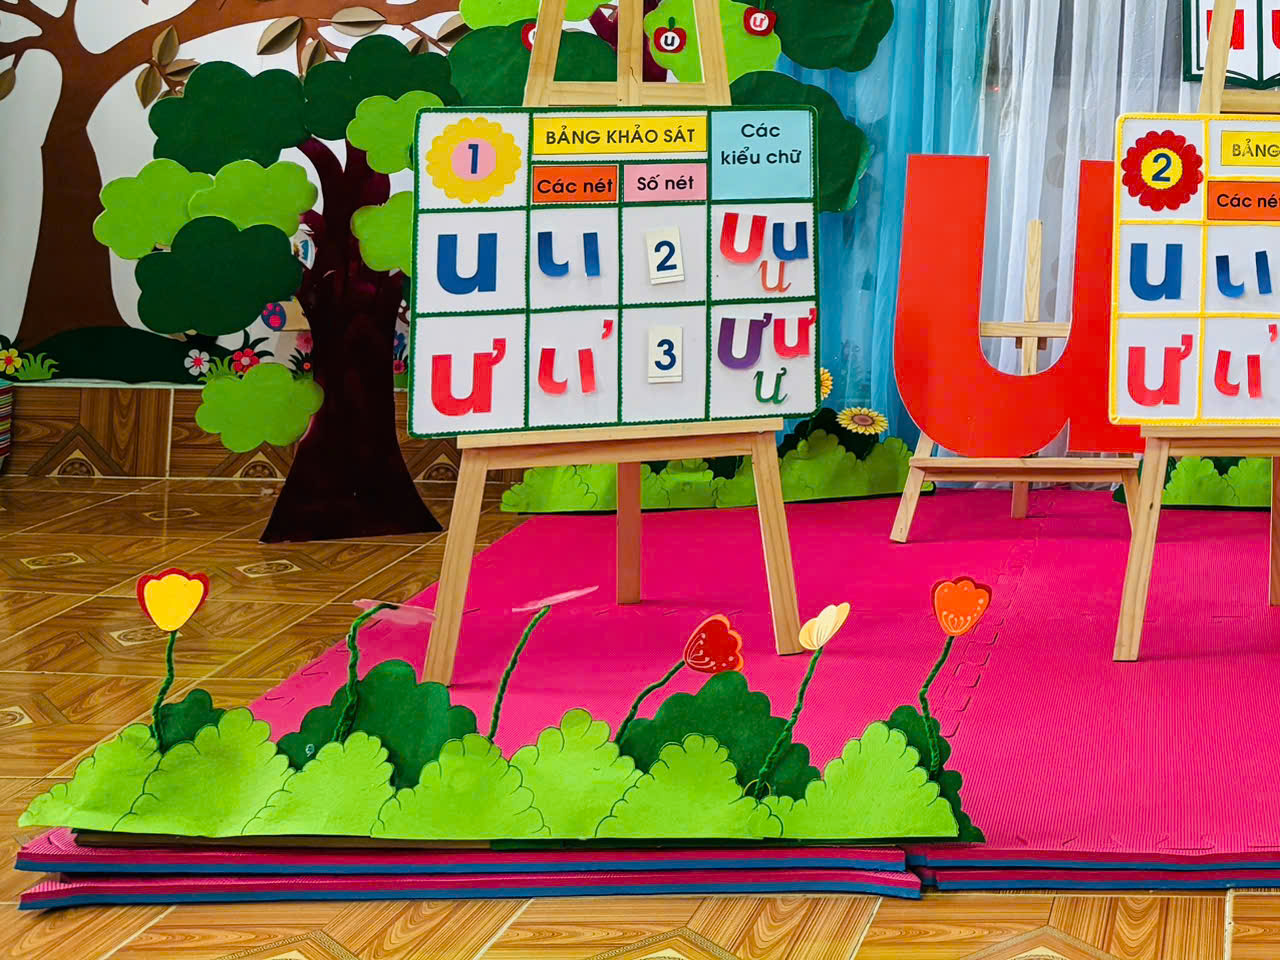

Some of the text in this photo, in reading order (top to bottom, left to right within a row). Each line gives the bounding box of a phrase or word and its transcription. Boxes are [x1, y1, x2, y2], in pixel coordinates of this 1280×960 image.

[663, 35, 676, 47] u
[546, 123, 695, 145] BẢNG KHẢO SÁT
[741, 123, 780, 138] Các
[468, 143, 479, 174] 1
[721, 145, 801, 165] kiểu chữ
[1232, 141, 1280, 157] BẢNG
[1151, 153, 1171, 182] 2
[537, 178, 613, 194] Các nét
[637, 176, 694, 190] Số nét
[1216, 194, 1252, 208] Các
[437, 232, 497, 295] u
[654, 240, 677, 272] 2
[1130, 243, 1183, 301] u
[654, 339, 676, 371] 3
[431, 338, 506, 417] ư
[1127, 334, 1193, 406] ư
